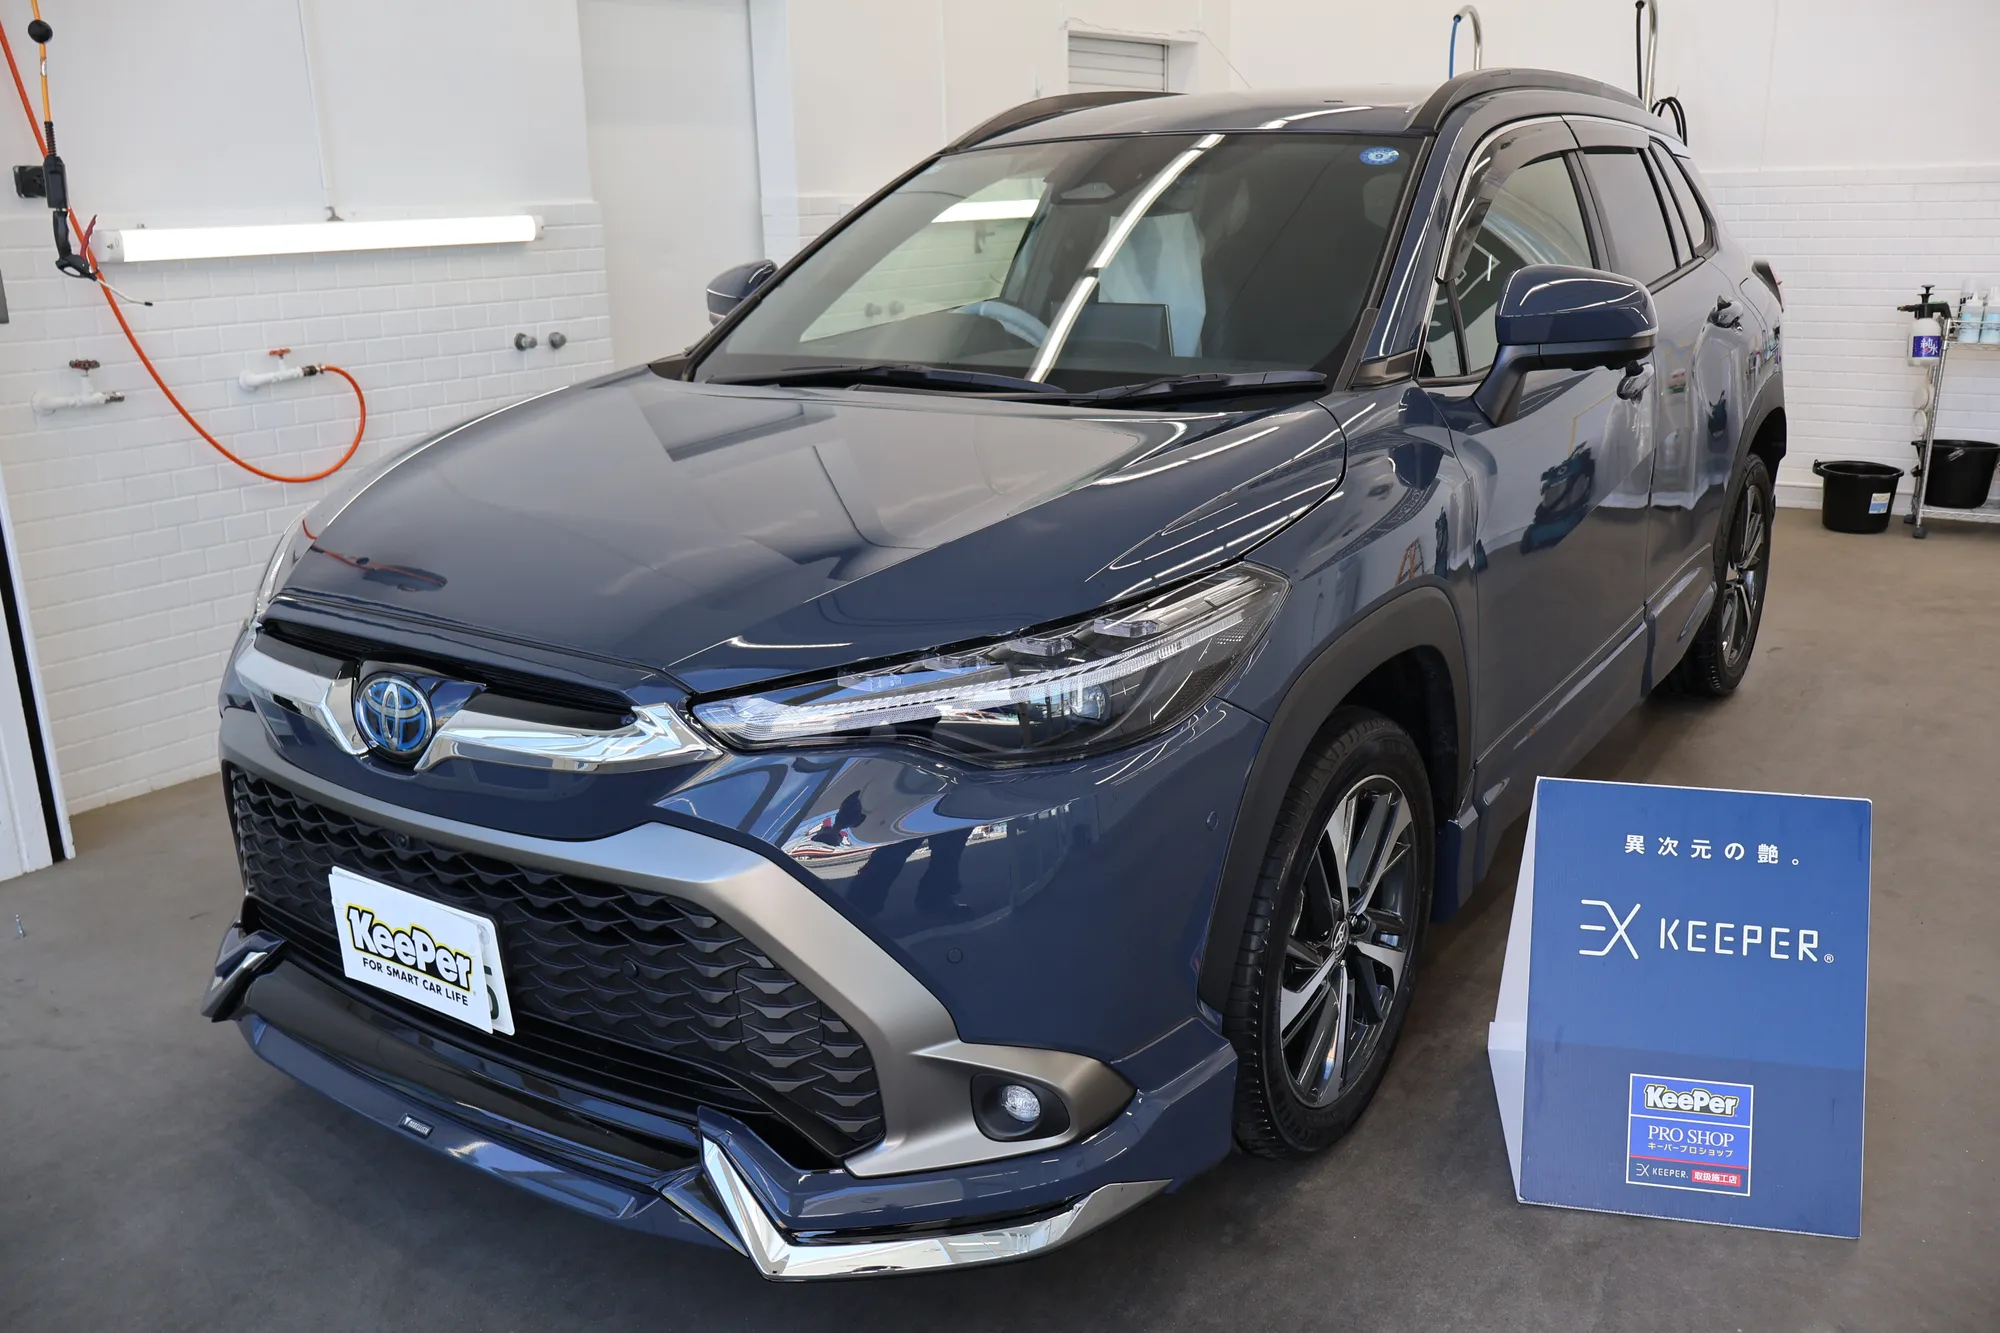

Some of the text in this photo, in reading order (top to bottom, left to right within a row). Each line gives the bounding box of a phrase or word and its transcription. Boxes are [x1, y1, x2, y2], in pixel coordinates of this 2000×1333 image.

[1624, 834, 1799, 866] 異次元の艶。
[347, 904, 473, 991] KeePer
[362, 957, 468, 1006] FOR SMART CAR LIFE
[1645, 1084, 1738, 1117] KeePer
[1648, 1125, 1735, 1147] PRO SHOP
[1694, 1171, 1738, 1185] 取扱施工店
